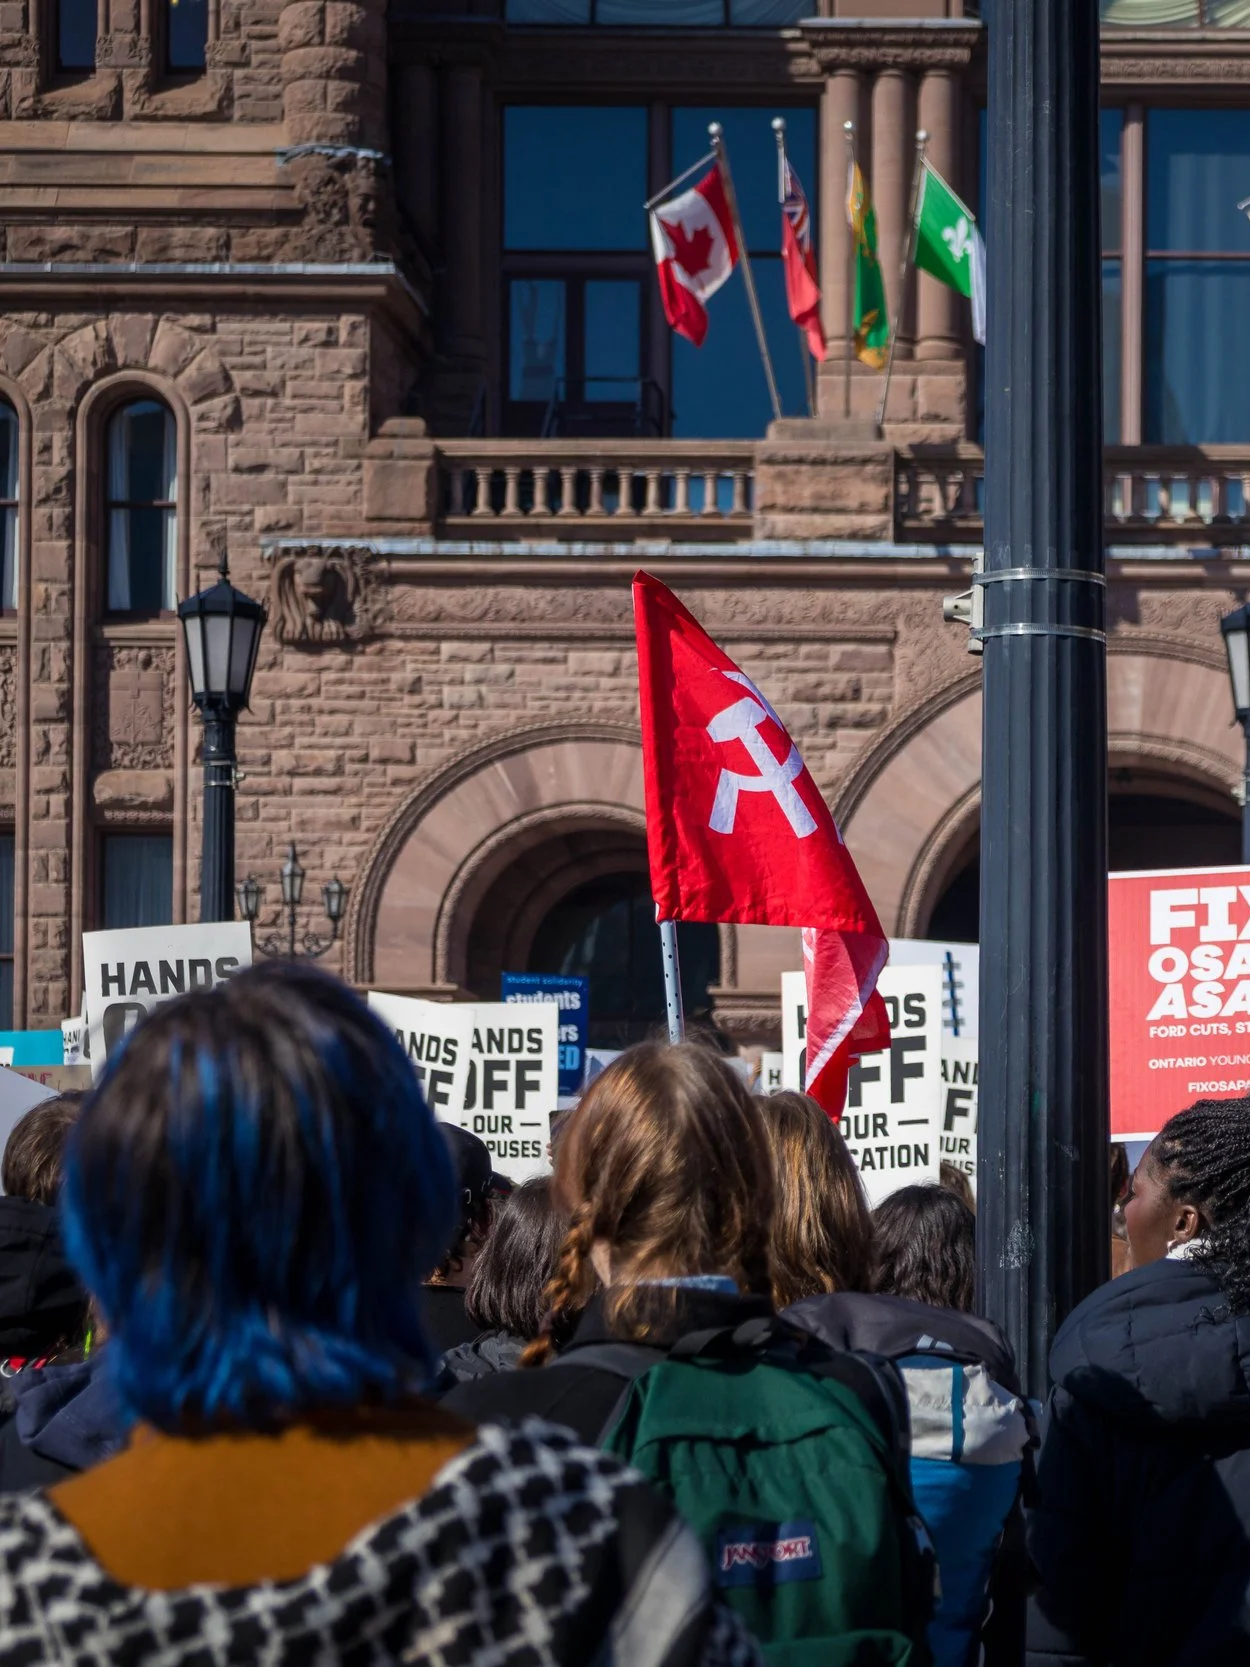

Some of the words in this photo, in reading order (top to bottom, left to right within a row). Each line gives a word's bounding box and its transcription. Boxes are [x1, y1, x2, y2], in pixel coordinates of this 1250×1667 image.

[1149, 1024, 1187, 1038] FORD
[1190, 1022, 1232, 1036] CUTS,
[472, 1028, 543, 1054] ANDS
[1148, 1056, 1207, 1069] ONTARIO
[473, 1115, 514, 1134] OUR
[486, 1140, 542, 1158] PUSES
[850, 1143, 929, 1172] CATION
